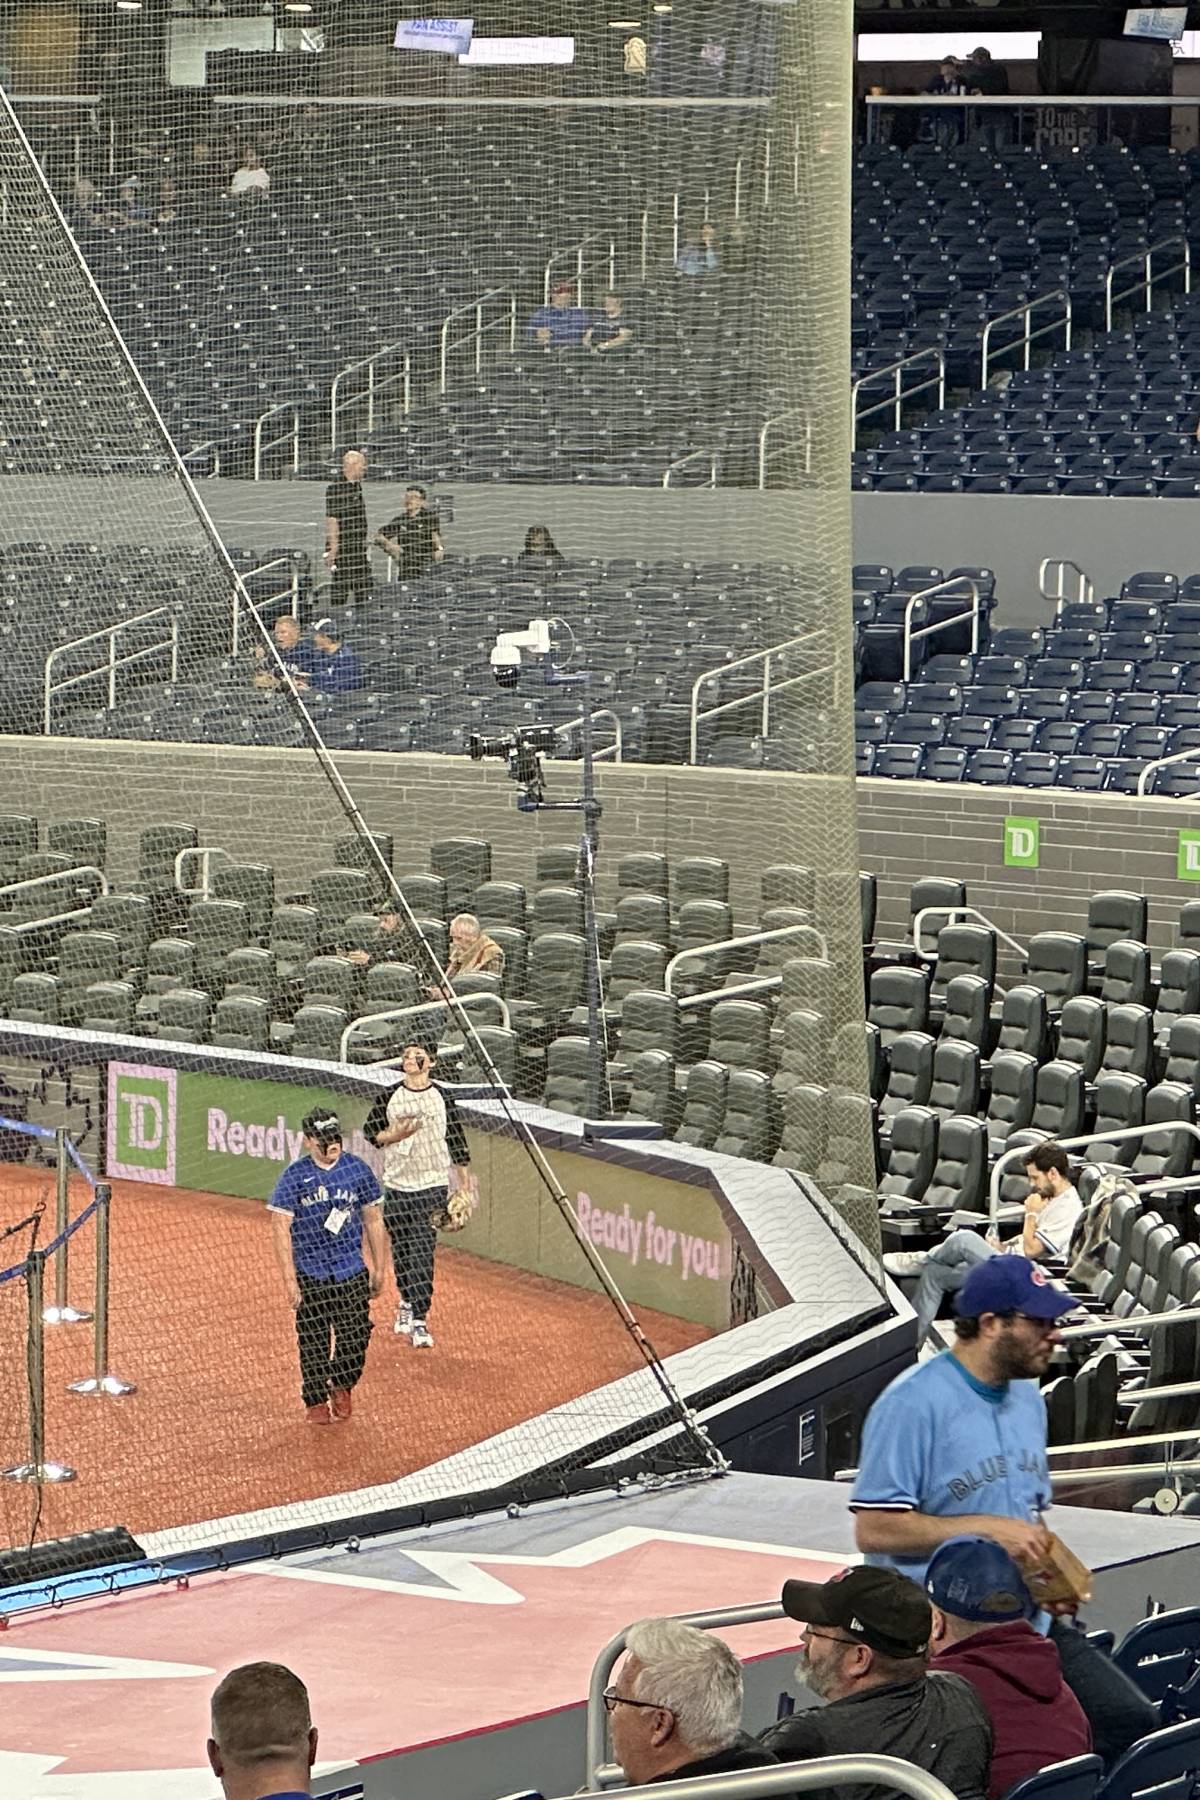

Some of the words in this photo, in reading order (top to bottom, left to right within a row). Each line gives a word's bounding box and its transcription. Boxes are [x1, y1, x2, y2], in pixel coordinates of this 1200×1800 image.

[1036, 108, 1057, 127] TO
[1058, 112, 1079, 126] THE
[1008, 827, 1035, 857] TD
[120, 1091, 163, 1149] TD
[577, 1191, 642, 1266] Ready
[646, 1210, 676, 1265] for
[681, 1232, 719, 1280] you
[946, 1455, 1009, 1501] BLUE
